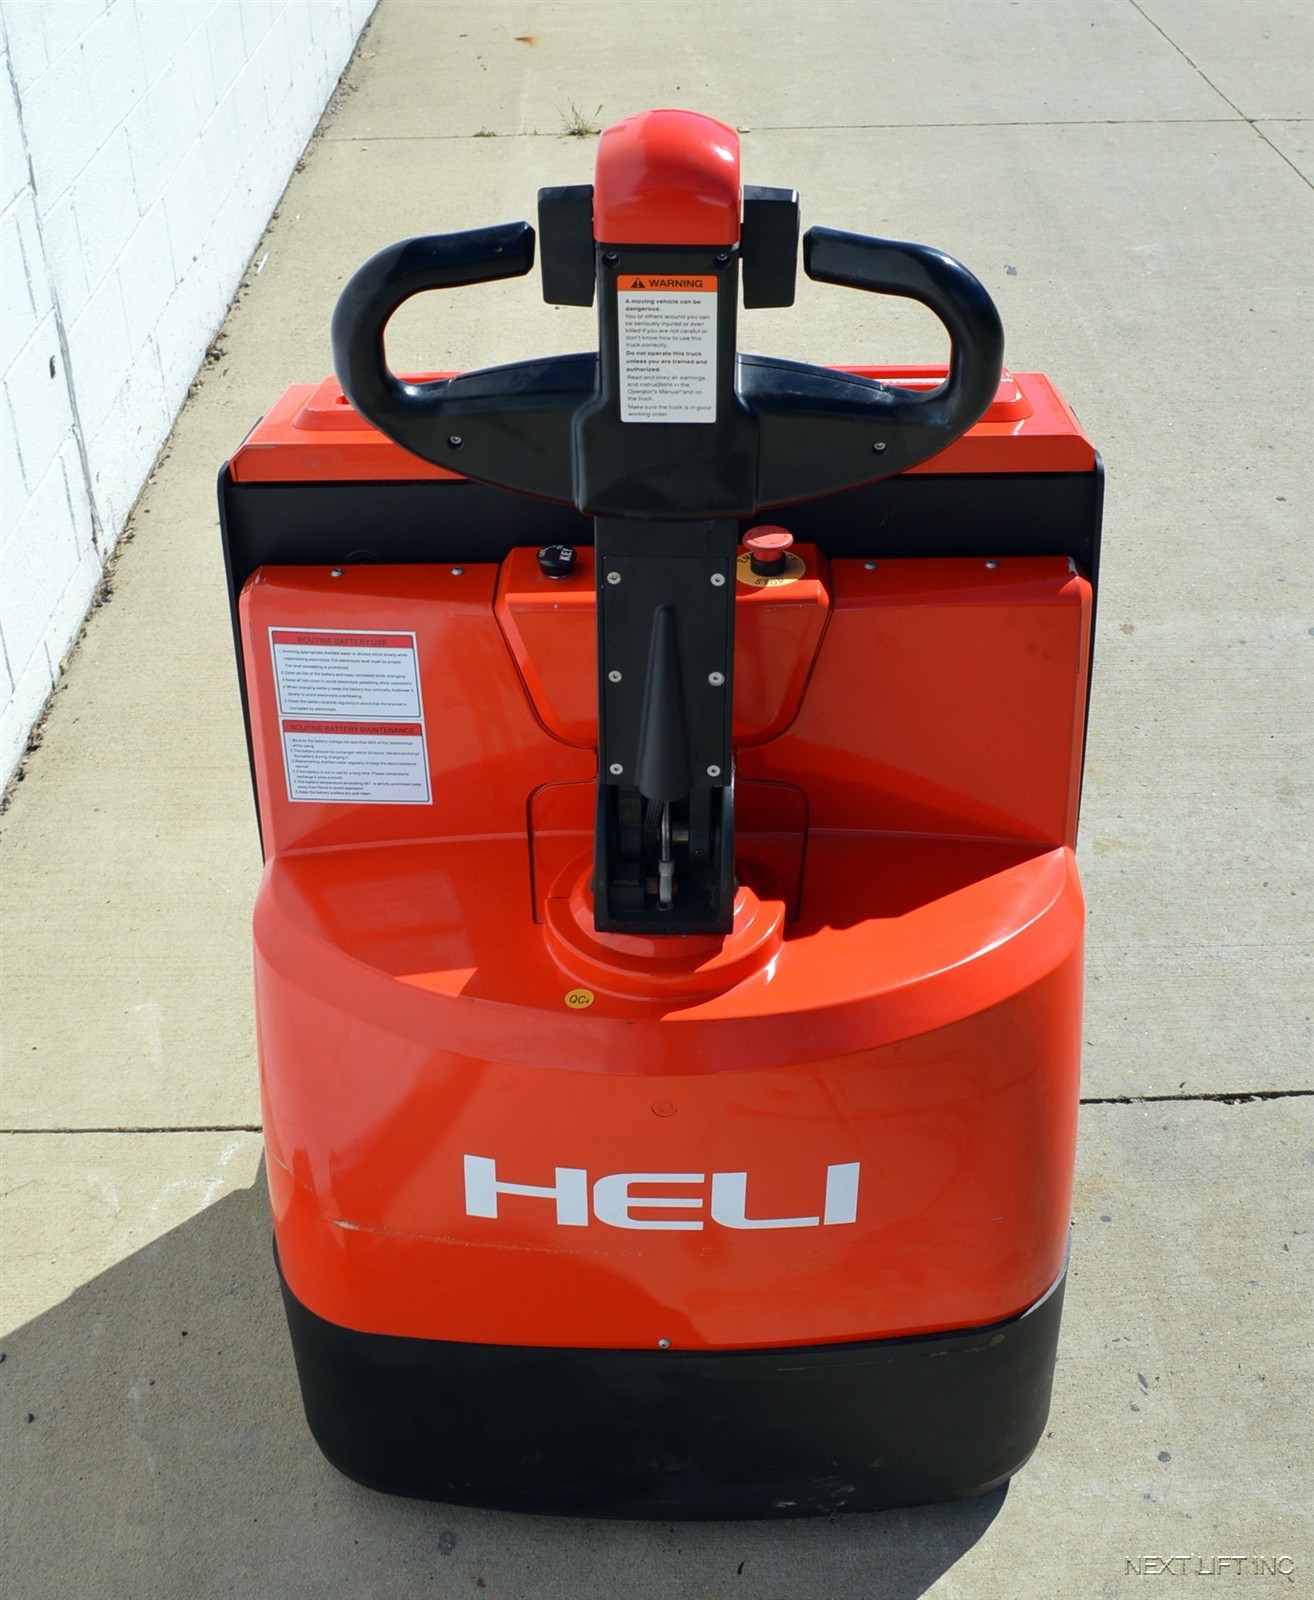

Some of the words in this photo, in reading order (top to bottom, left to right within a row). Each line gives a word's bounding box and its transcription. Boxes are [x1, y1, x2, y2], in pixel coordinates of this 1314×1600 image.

[648, 279, 703, 288] WARNING
[559, 548, 573, 561] KEY
[298, 636, 332, 644] ROUTINE
[360, 726, 415, 734] MAINTENANCE
[463, 1154, 860, 1231] HELI
